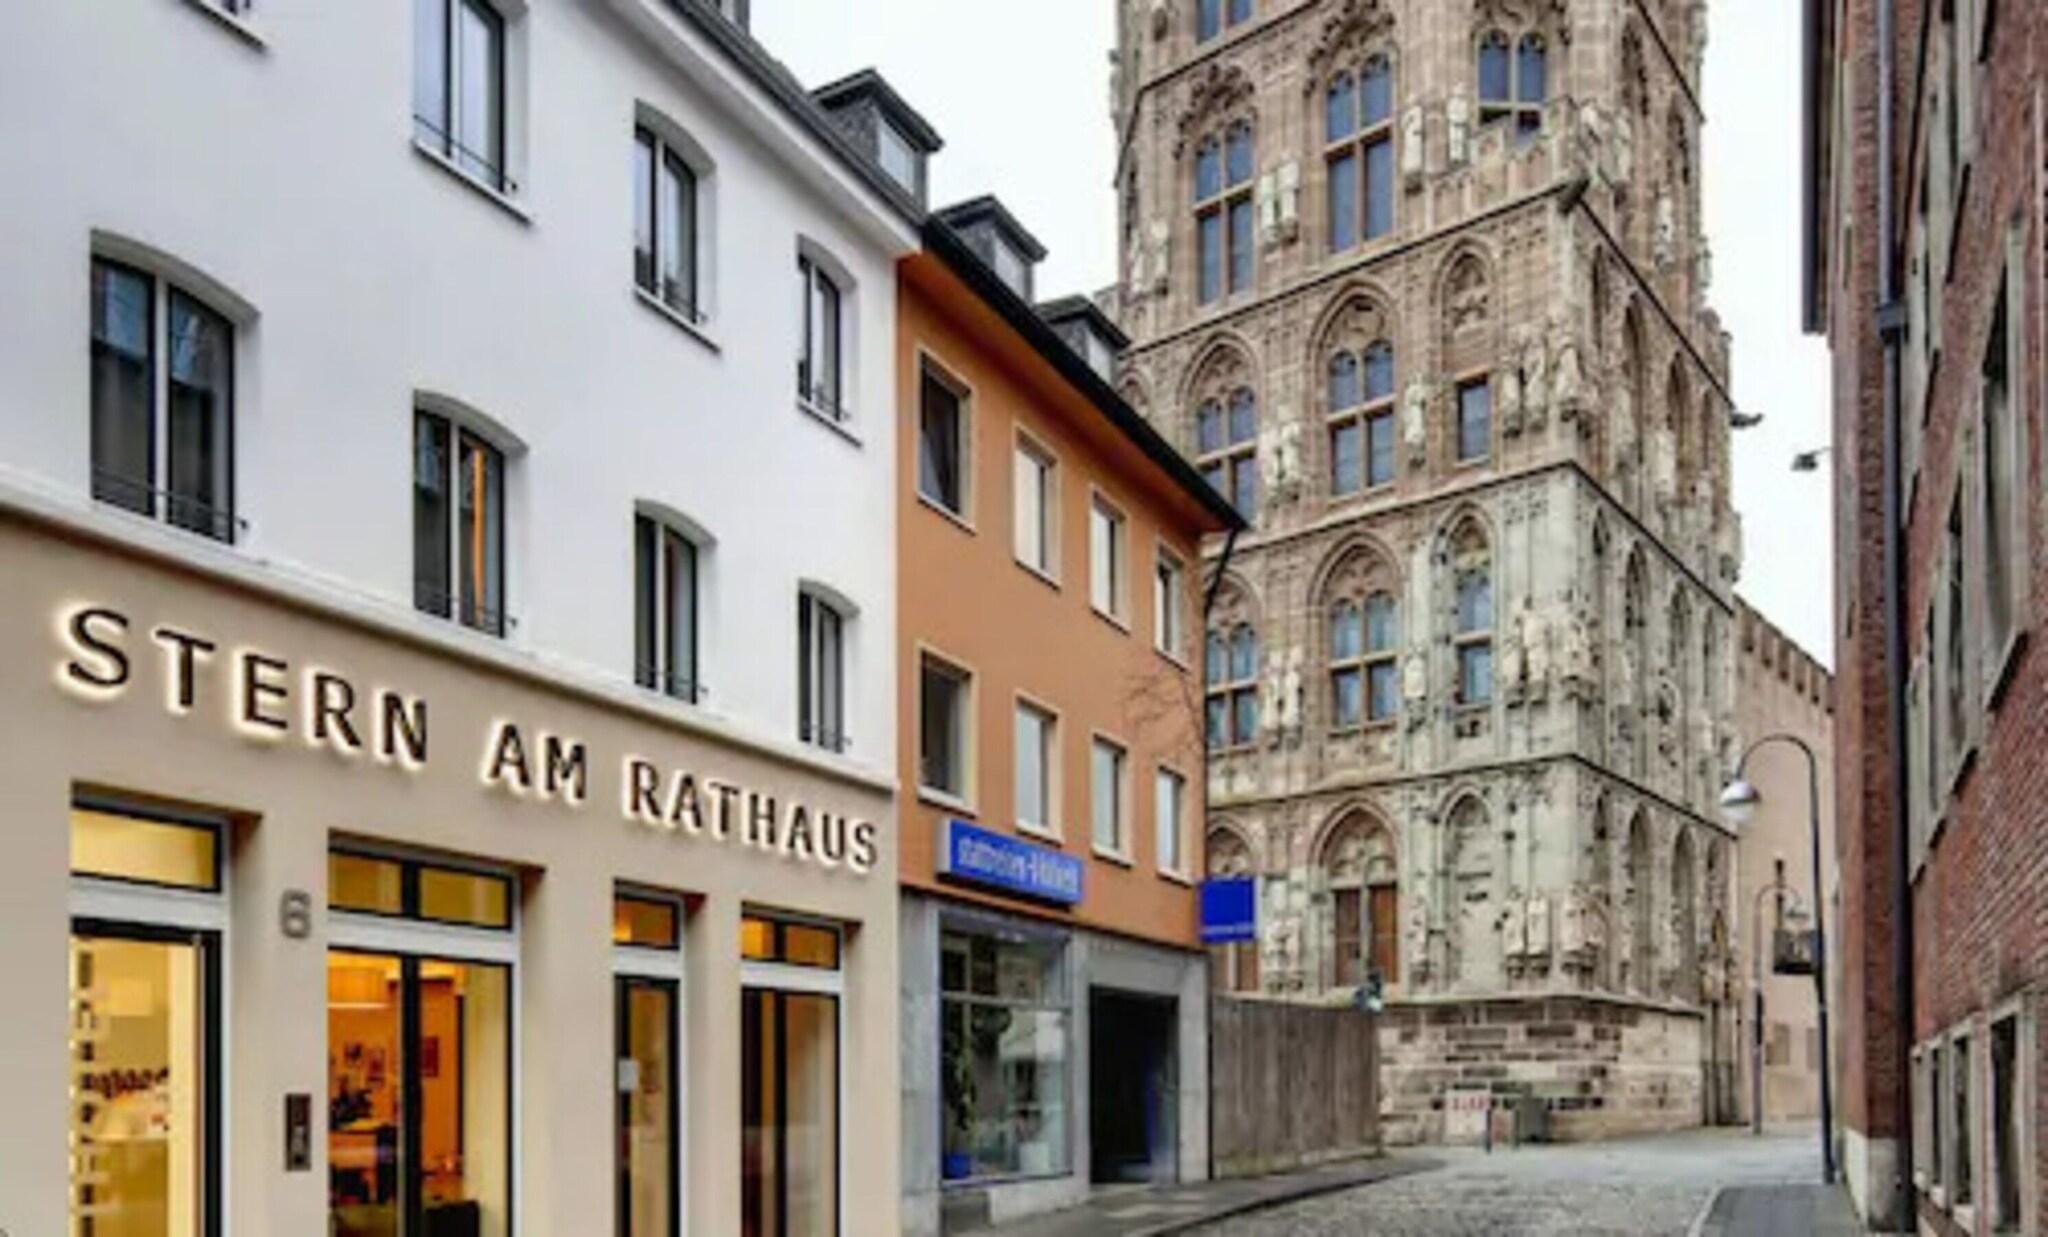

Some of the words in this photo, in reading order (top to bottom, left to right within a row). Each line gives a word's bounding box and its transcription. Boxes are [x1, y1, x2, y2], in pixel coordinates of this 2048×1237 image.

[66, 606, 428, 763] STERN
[488, 722, 588, 800] AM
[627, 758, 878, 868] RATHAUS
[279, 889, 311, 939] 6
